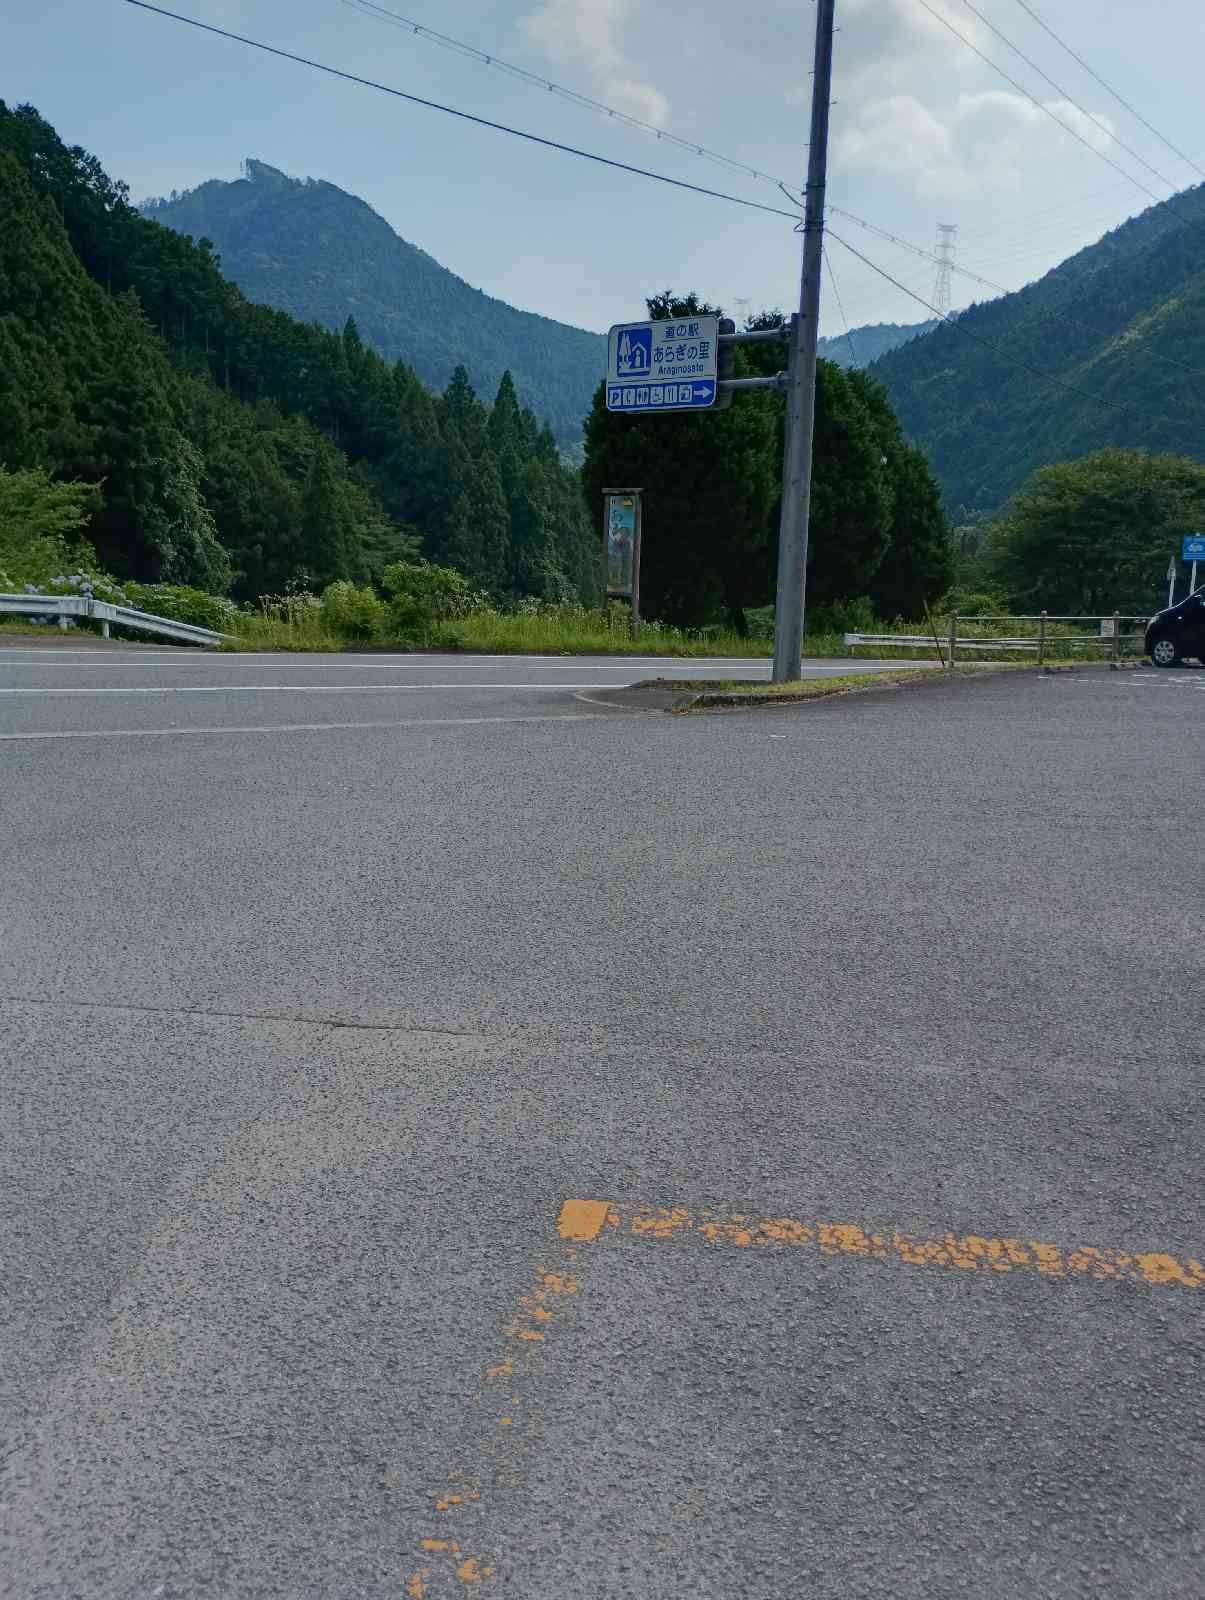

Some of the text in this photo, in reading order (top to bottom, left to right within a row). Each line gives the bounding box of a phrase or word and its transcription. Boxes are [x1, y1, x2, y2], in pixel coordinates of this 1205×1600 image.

[664, 323, 700, 339] 道の駅
[654, 342, 710, 363] あらぎの里
[658, 363, 704, 376] Araginosato
